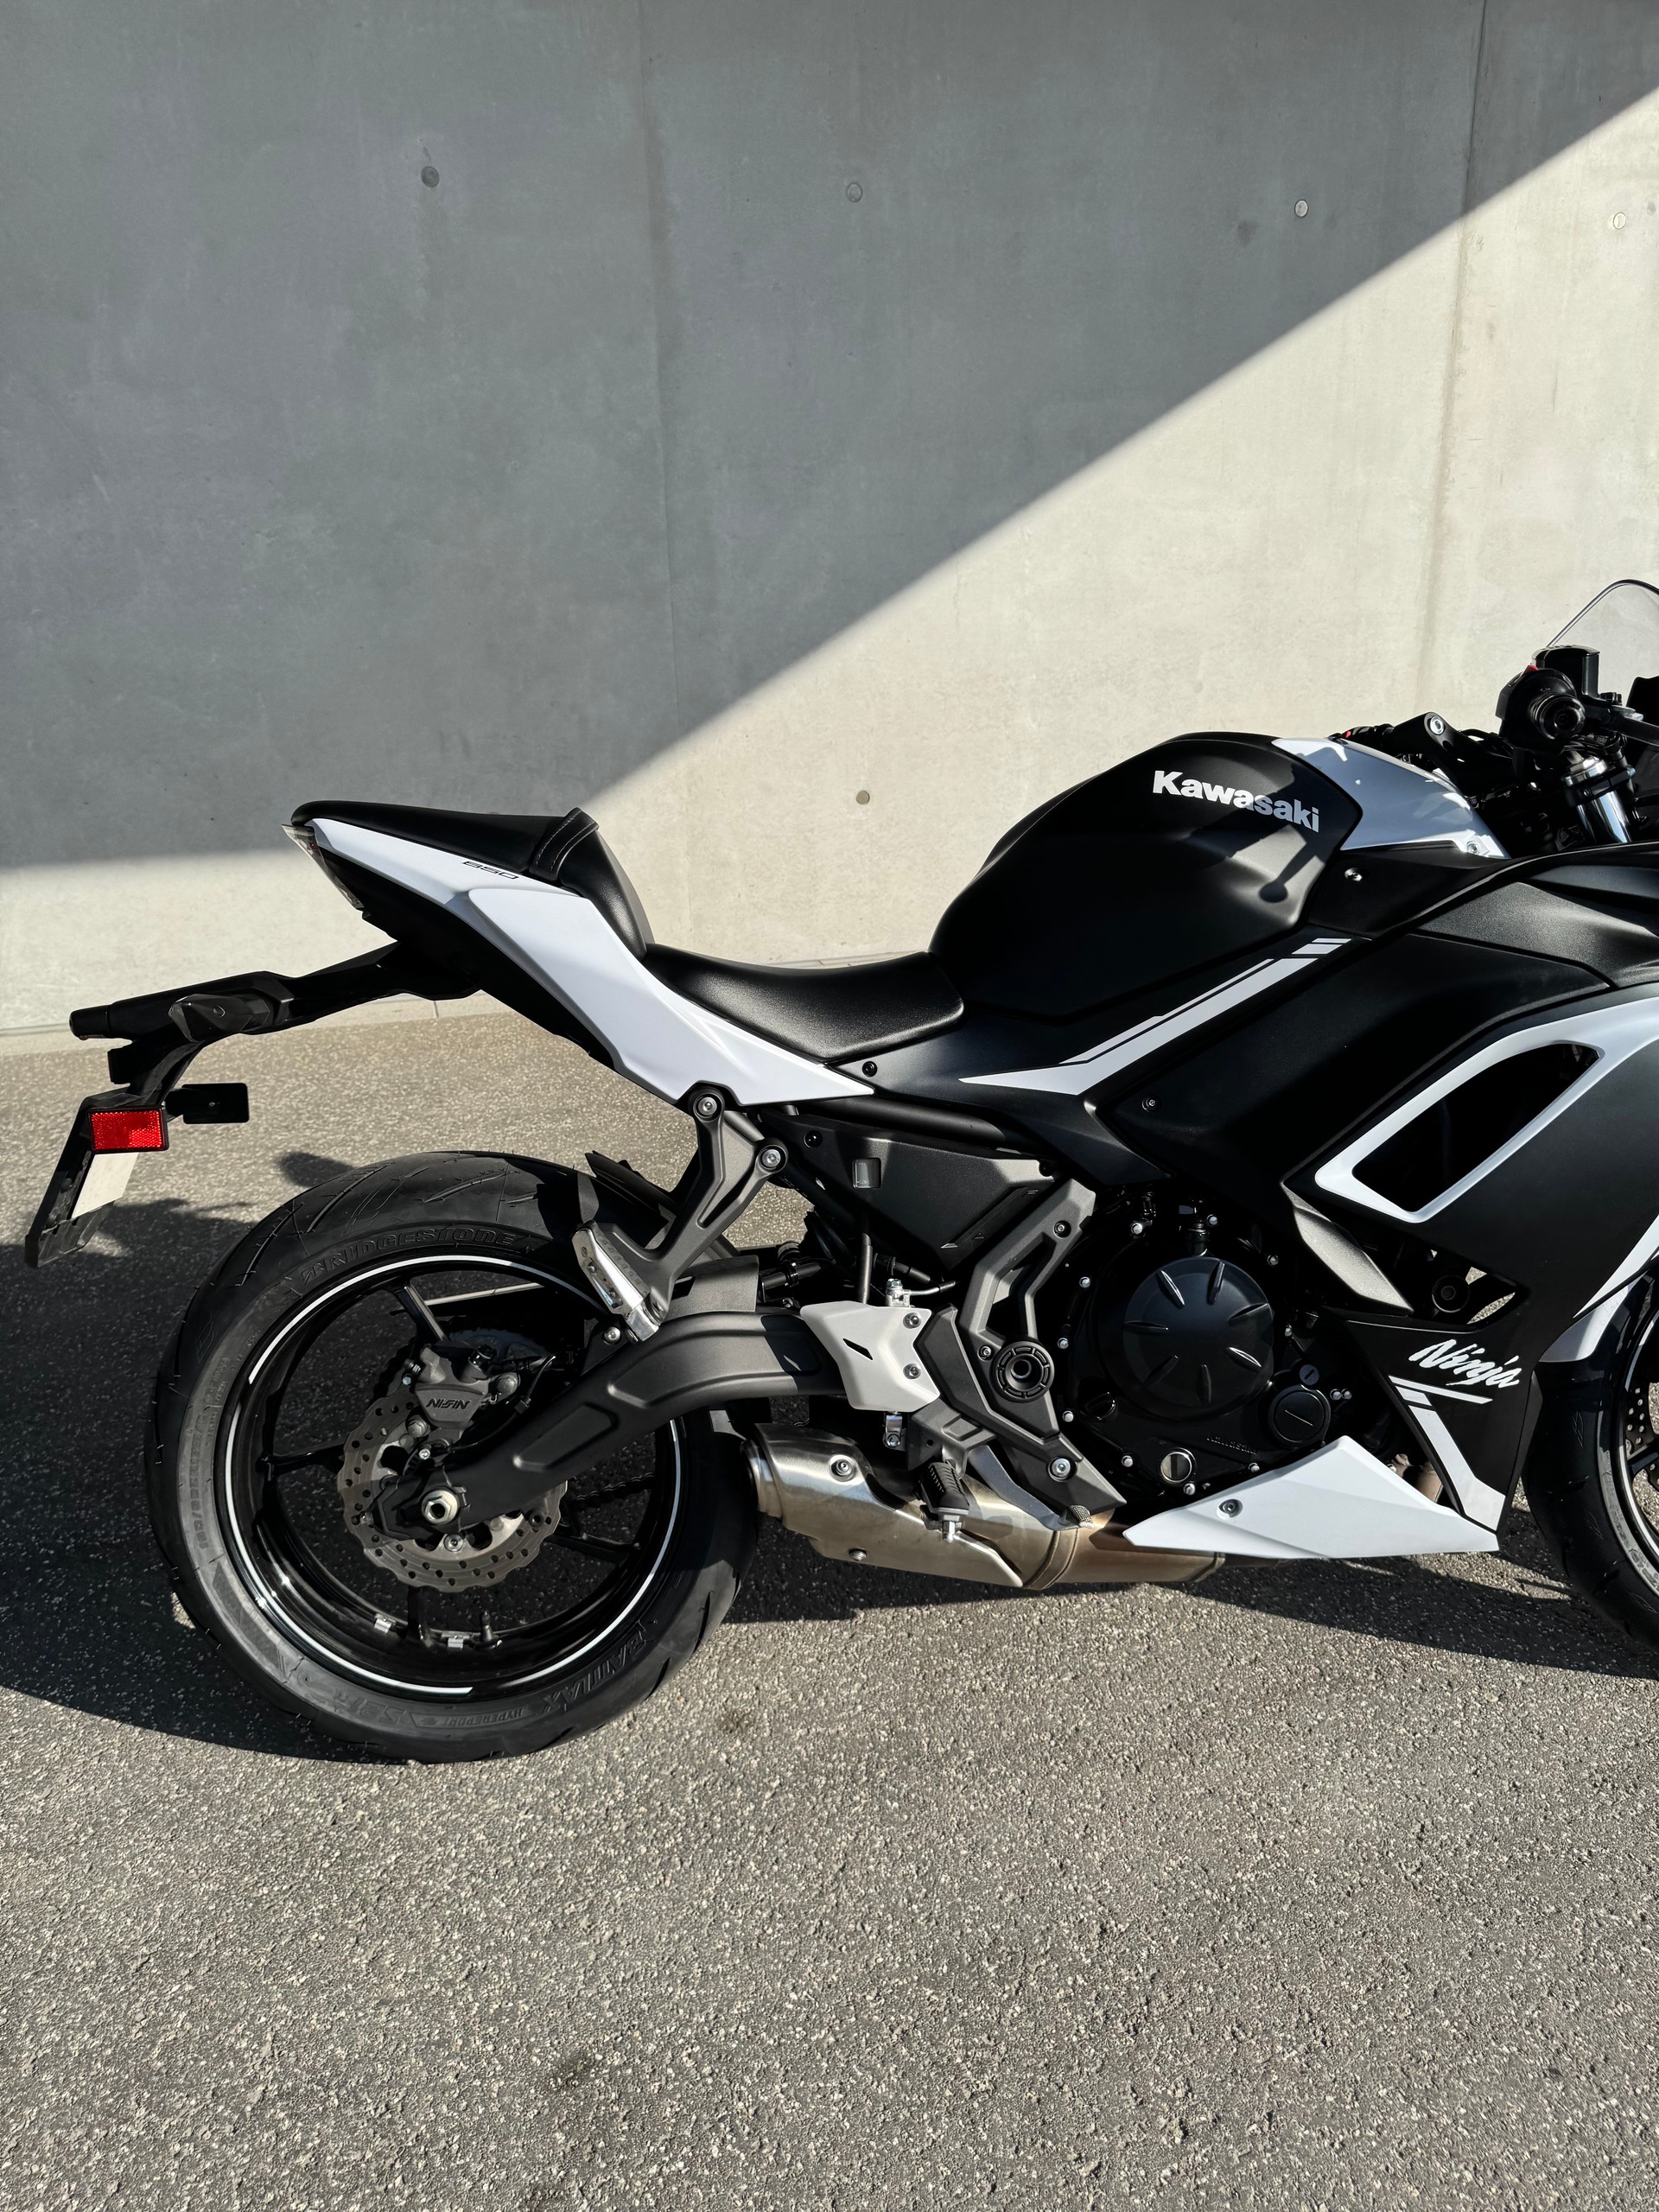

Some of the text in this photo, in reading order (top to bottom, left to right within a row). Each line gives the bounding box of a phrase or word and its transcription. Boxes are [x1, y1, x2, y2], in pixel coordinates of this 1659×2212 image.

[1153, 770, 1319, 832] Kawasaki
[463, 861, 519, 879] 650
[301, 1227, 516, 1285] BRIDGESTONE
[1408, 1339, 1522, 1389] Ninja
[542, 1628, 646, 1713] BATTLAX
